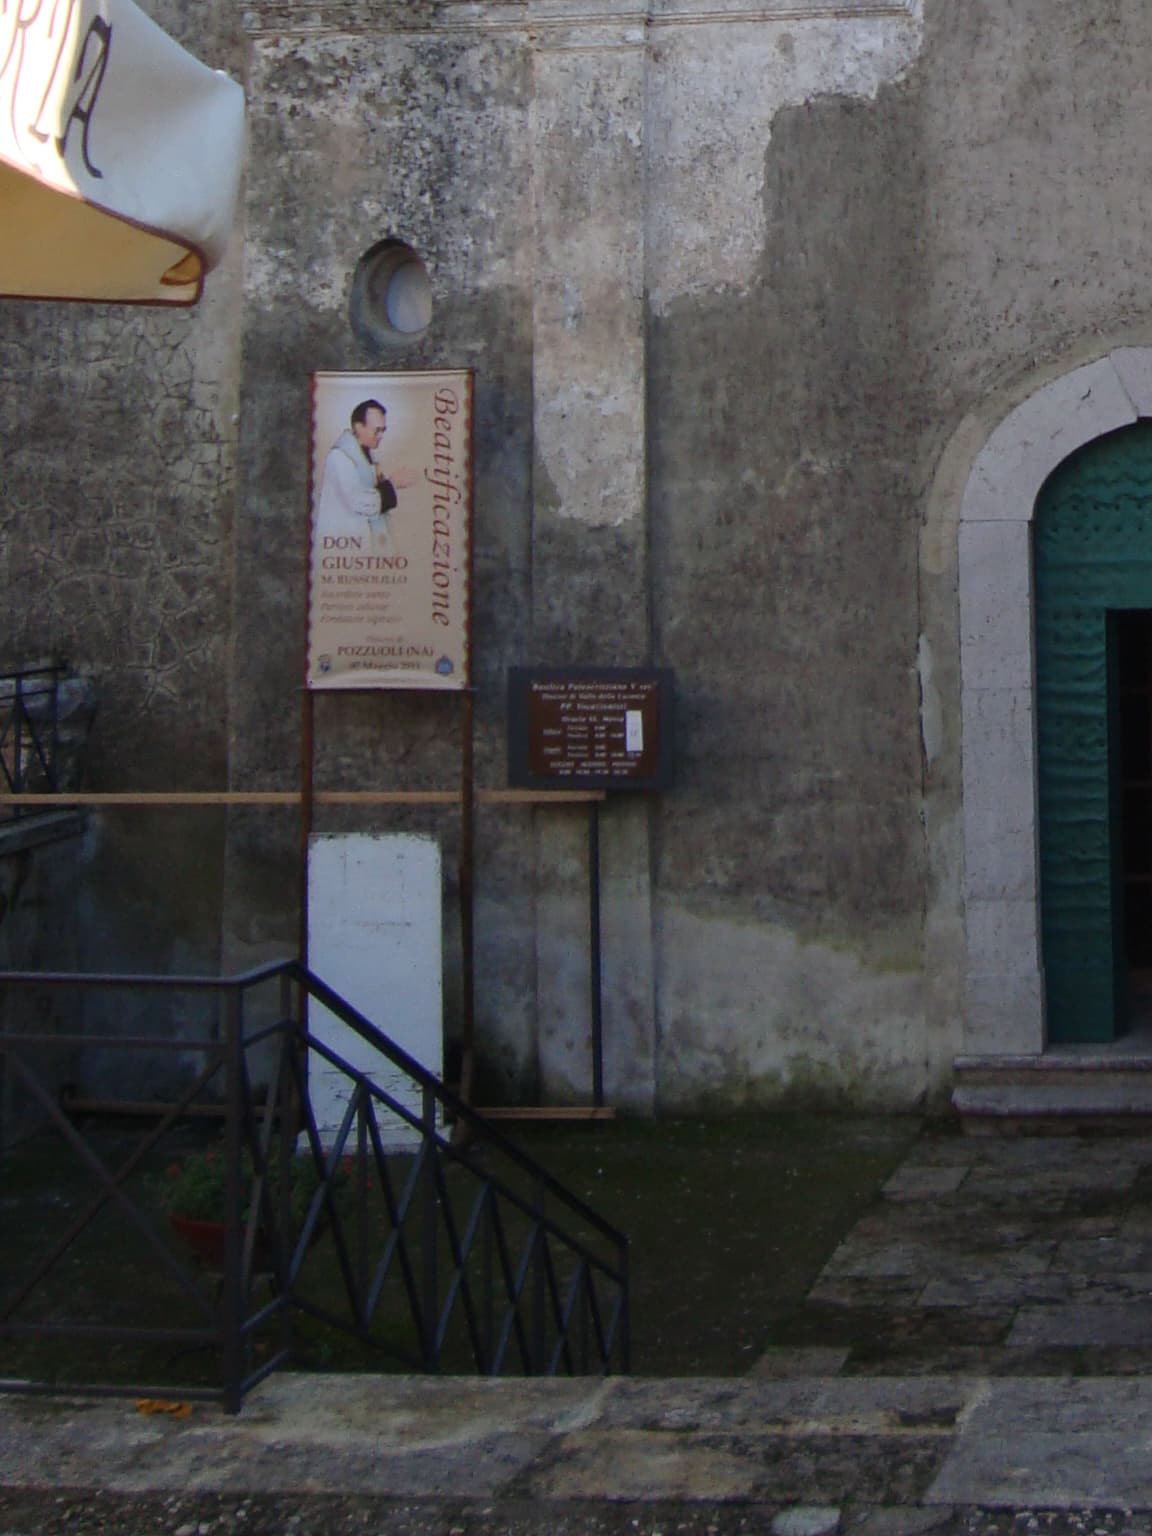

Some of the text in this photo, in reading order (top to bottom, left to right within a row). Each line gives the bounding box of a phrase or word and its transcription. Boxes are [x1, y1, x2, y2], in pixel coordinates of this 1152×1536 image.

[424, 388, 461, 627] Beatificazione
[323, 536, 362, 549] DON
[322, 556, 408, 569] GIUSTINO
[337, 645, 434, 657] POZZUOLI (NA)
